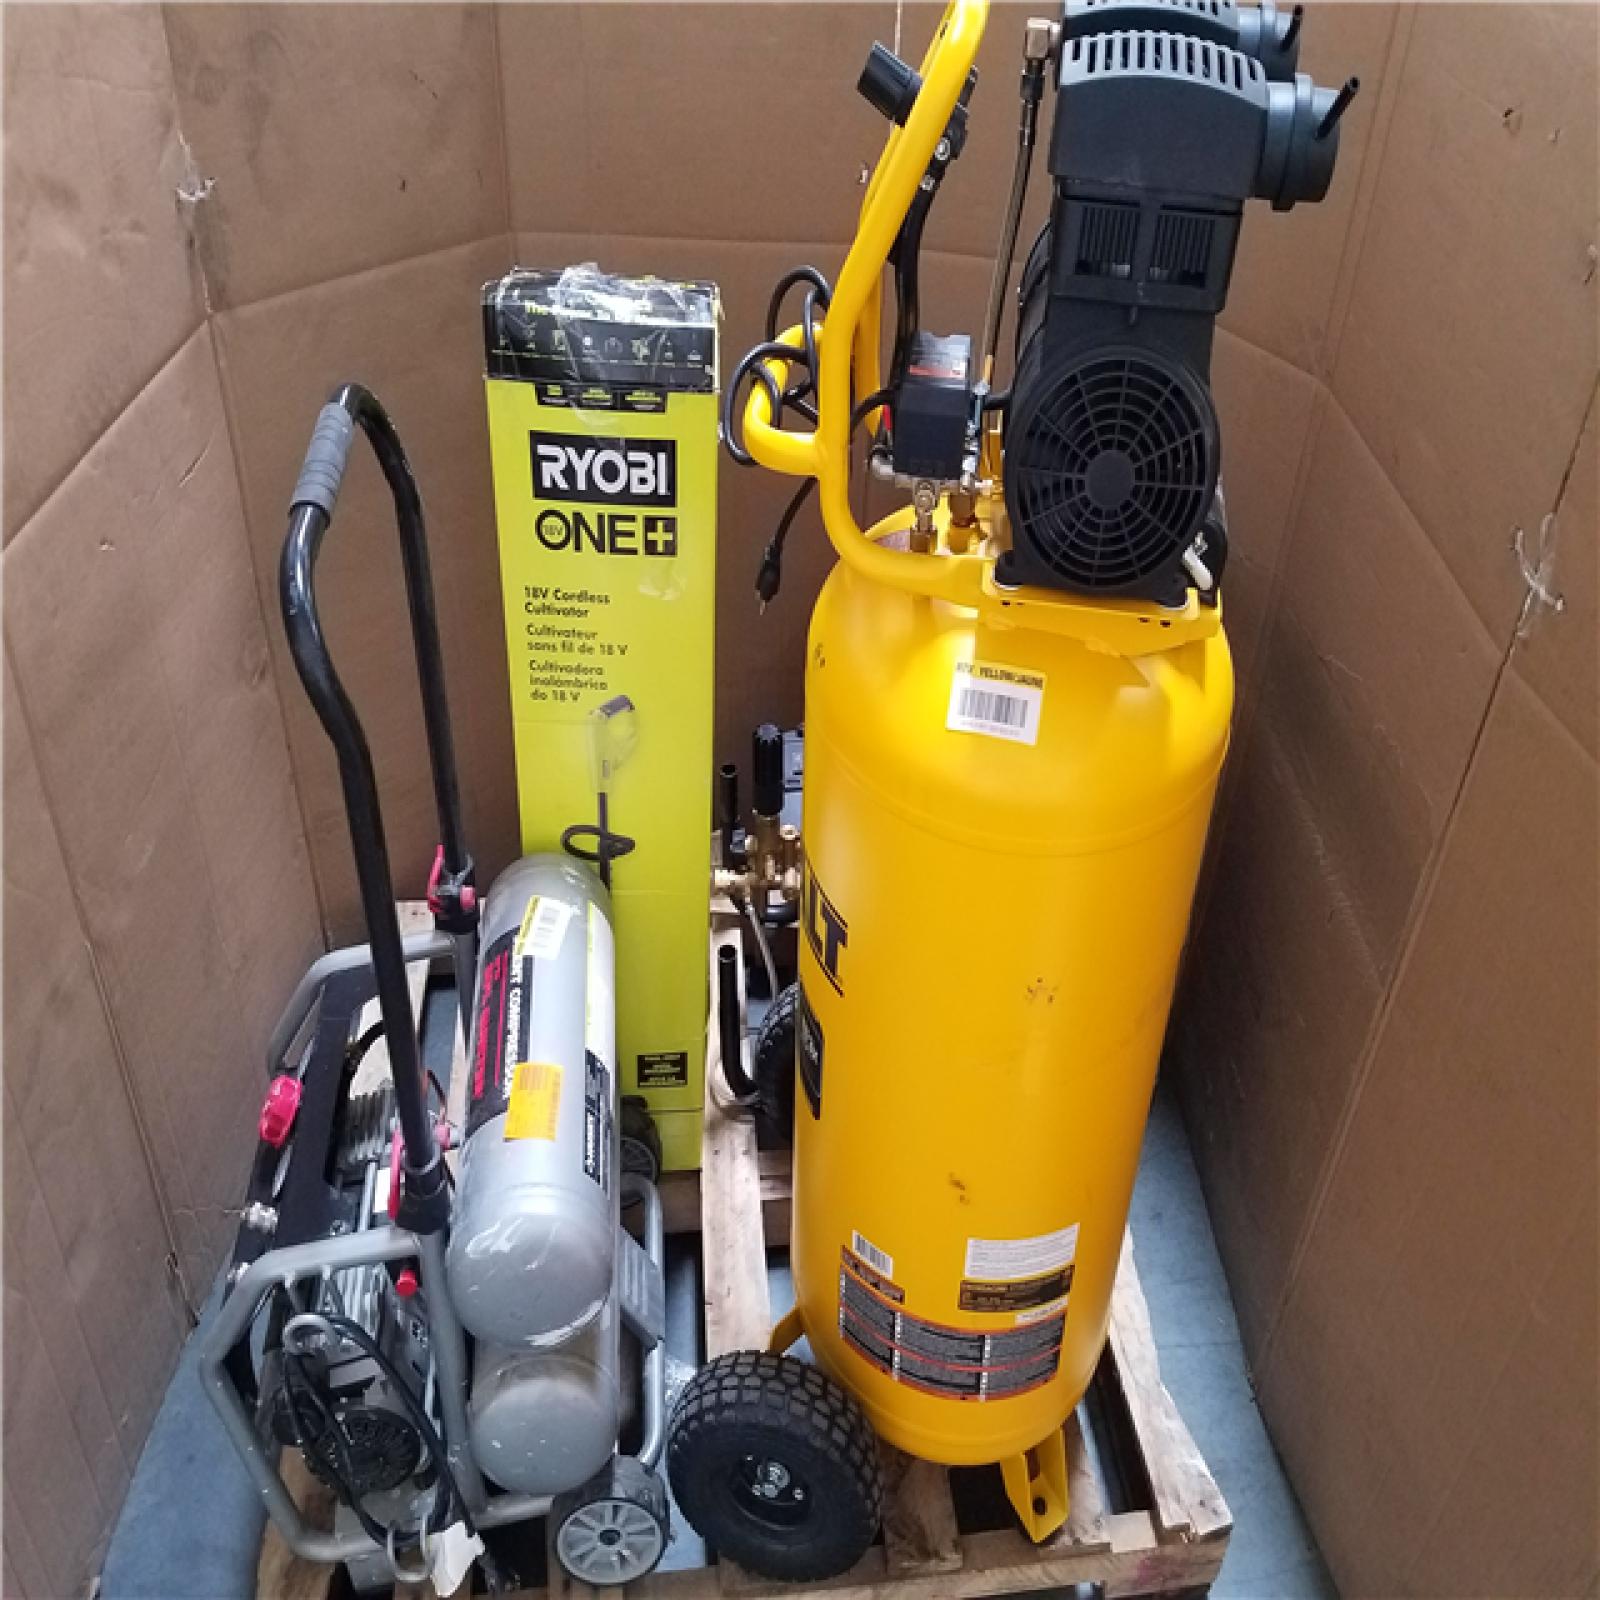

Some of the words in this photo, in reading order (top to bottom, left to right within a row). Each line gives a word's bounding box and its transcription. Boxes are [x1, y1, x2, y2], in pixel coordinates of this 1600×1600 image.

[537, 444, 671, 495] RYOBI
[524, 585, 549, 599] 18V
[552, 589, 610, 604] Cordless
[524, 601, 589, 618] Cultivator
[527, 624, 598, 640] Cultivateur
[527, 641, 557, 652] sans
[561, 640, 575, 653] fil
[577, 643, 595, 655] de
[599, 644, 614, 655] 18
[617, 644, 628, 655] V
[529, 660, 603, 675] Cultivadora
[552, 689, 566, 702] 18
[569, 691, 581, 702] V
